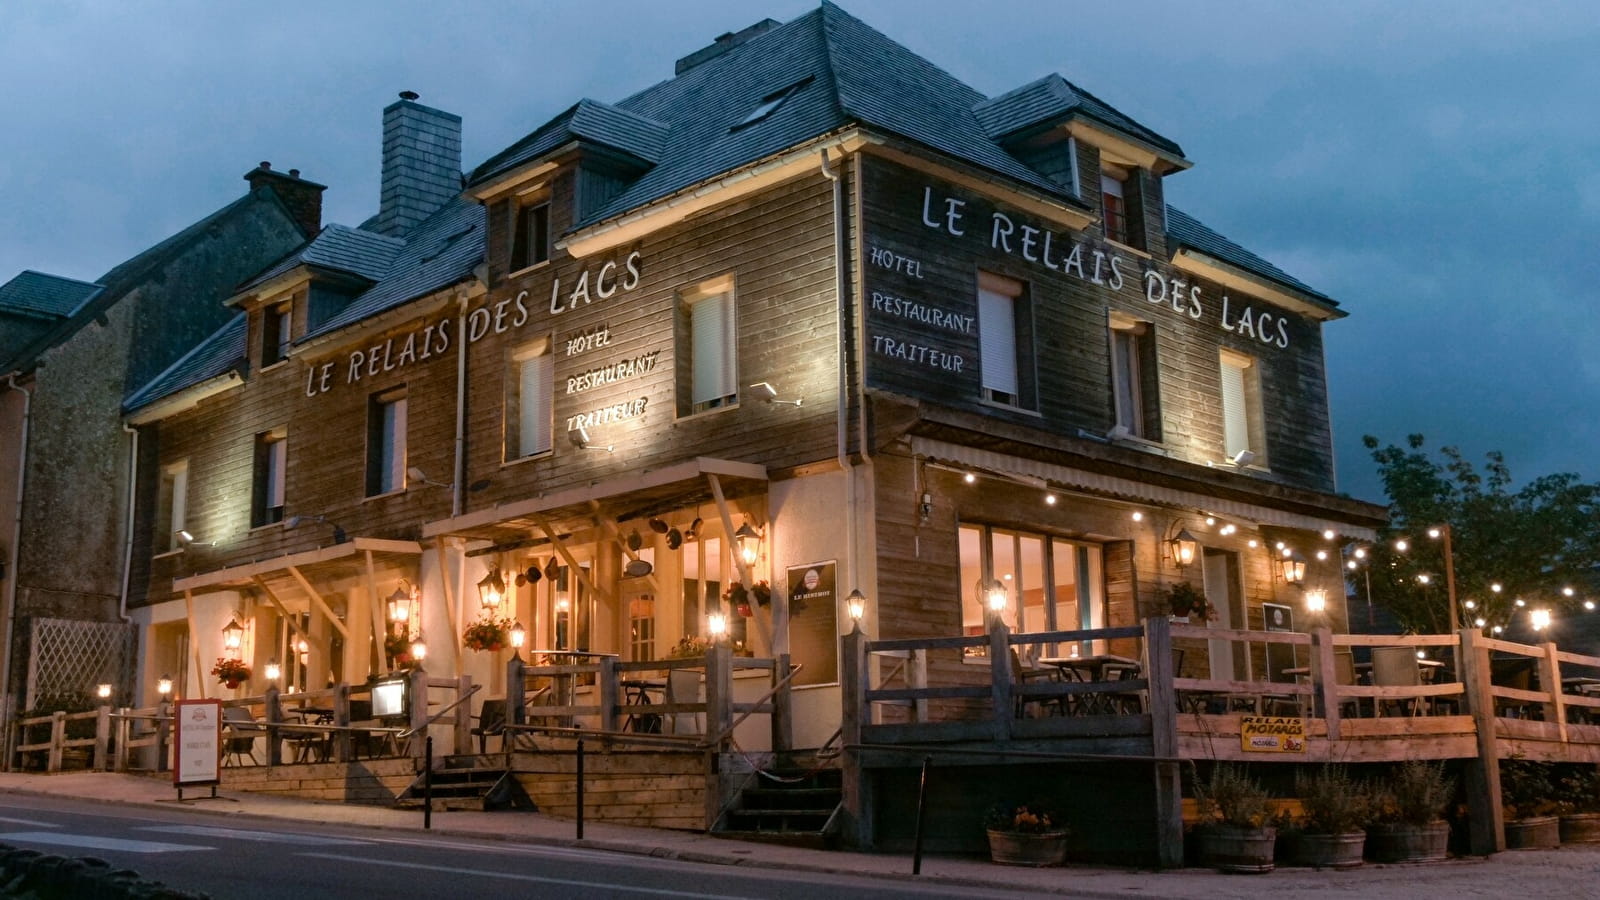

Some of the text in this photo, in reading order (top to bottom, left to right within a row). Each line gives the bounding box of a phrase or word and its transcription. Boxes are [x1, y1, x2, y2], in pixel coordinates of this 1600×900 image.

[871, 247, 924, 279] HOTEL
[922, 186, 1289, 348] LE RELAIS DES LACS
[306, 251, 641, 398] LE RELAIS DES LACS
[871, 292, 974, 333] RESTAURANT
[566, 329, 610, 356] HOTEL
[873, 335, 964, 373] TRAITEUR
[566, 355, 656, 394] RESTAURANT
[566, 399, 647, 431] TRAITEUR
[1243, 717, 1301, 725] RELAIS
